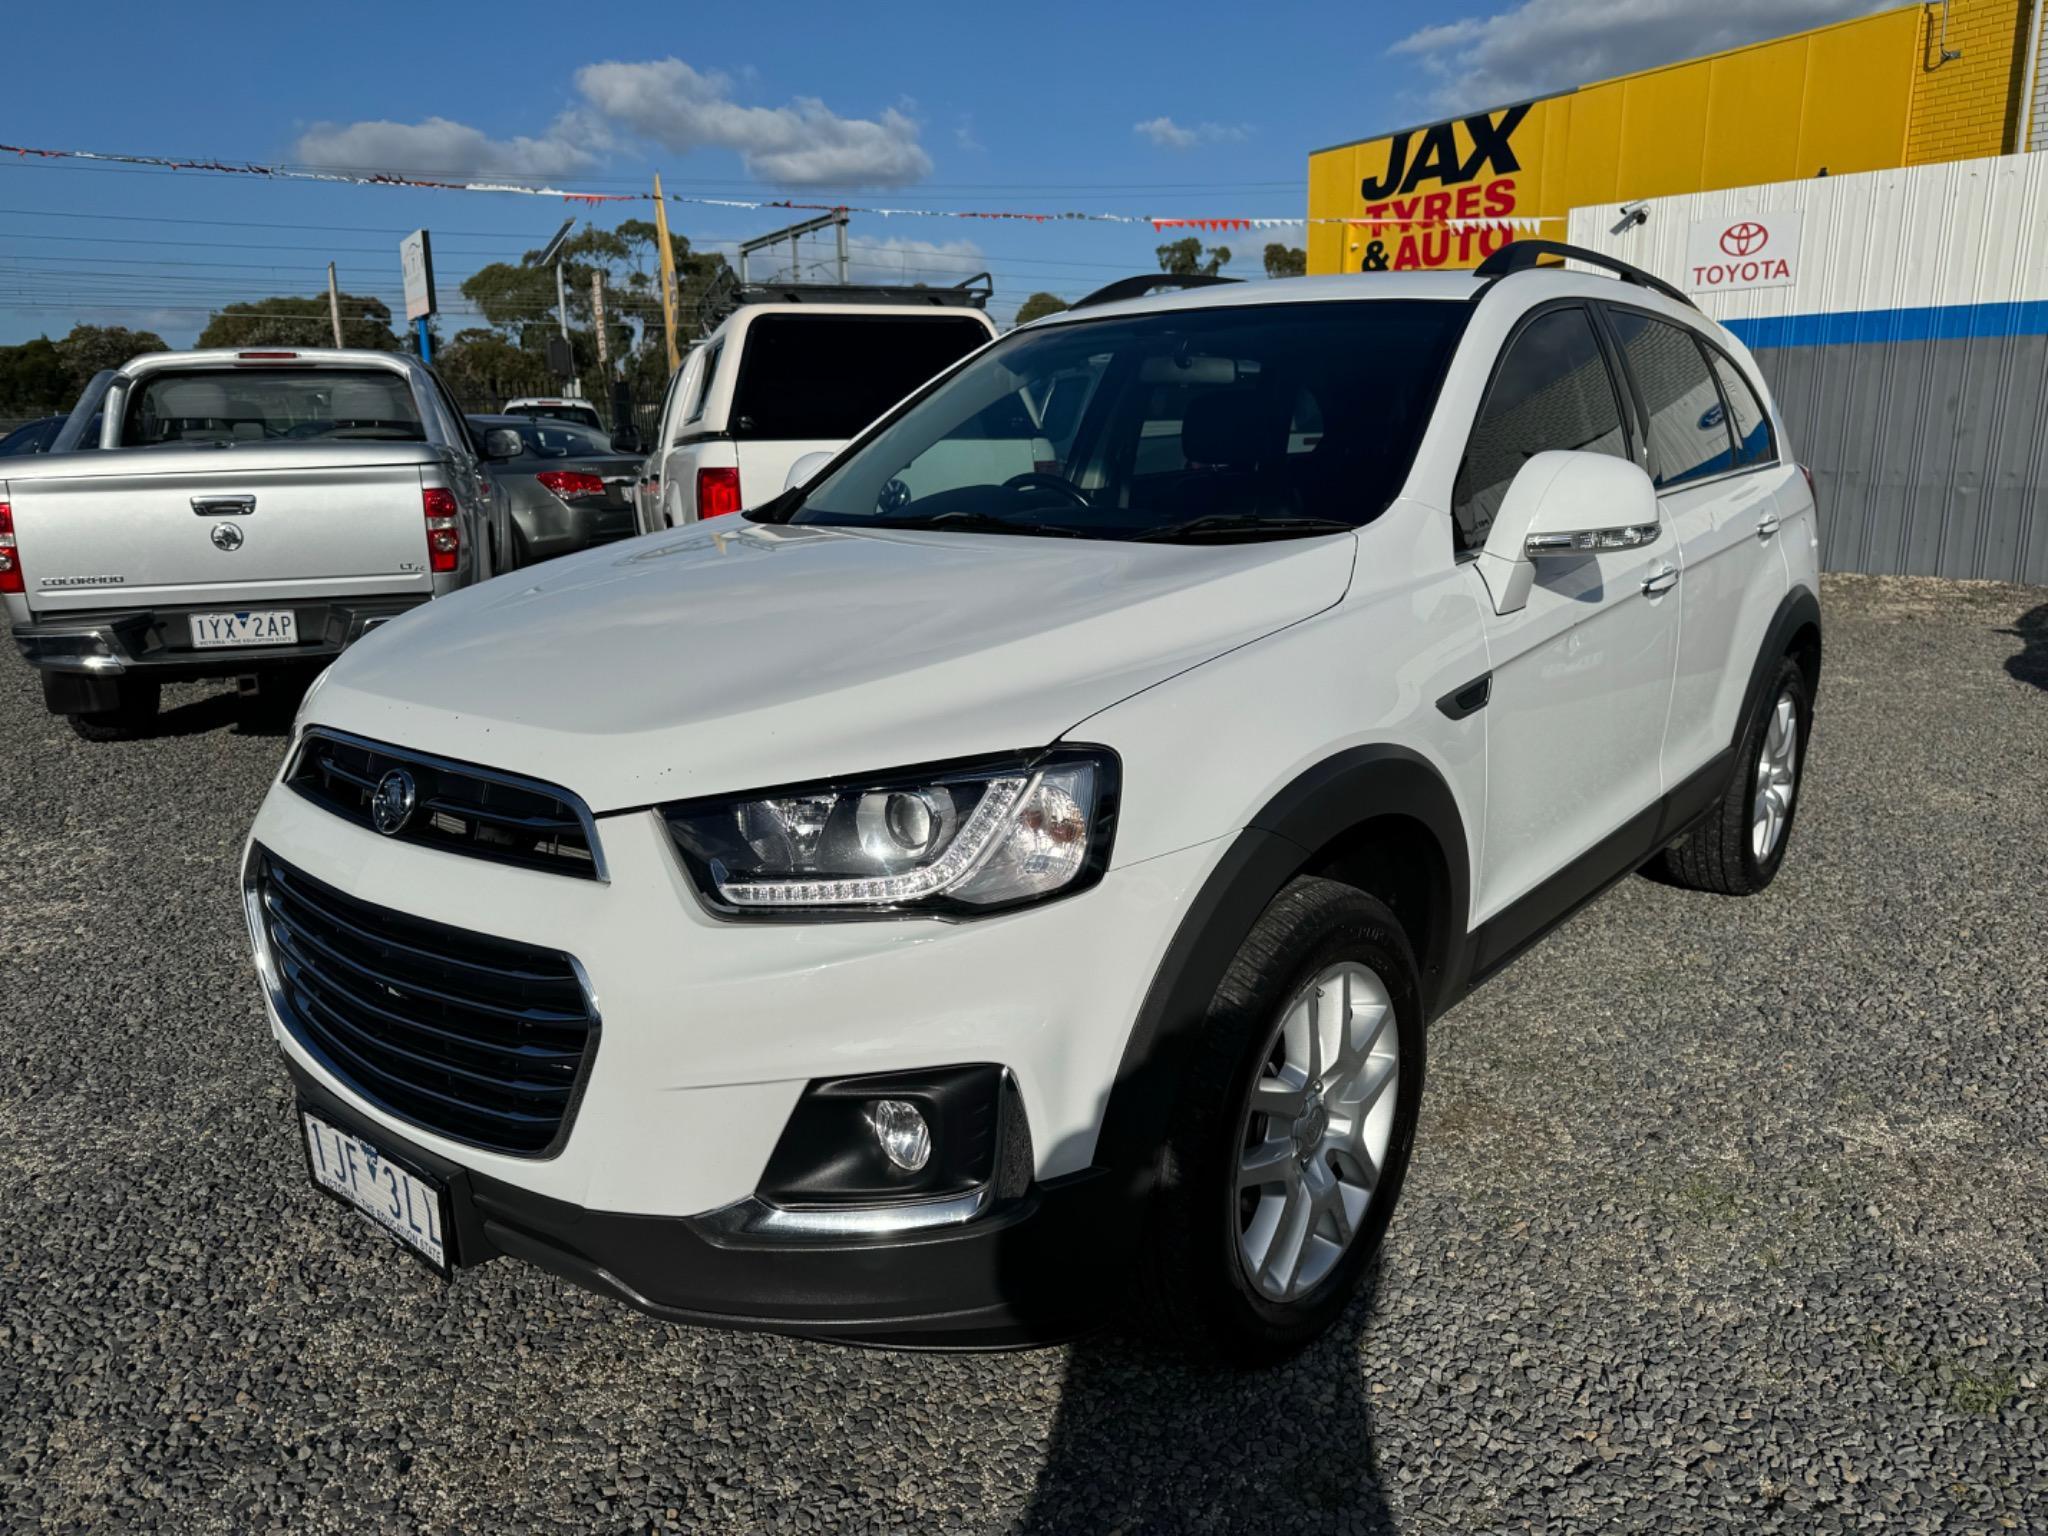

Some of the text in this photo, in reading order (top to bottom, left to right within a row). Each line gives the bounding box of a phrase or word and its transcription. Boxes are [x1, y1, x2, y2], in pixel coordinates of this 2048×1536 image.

[1361, 102, 1535, 202] JAX
[1366, 179, 1516, 238] TYRES
[1361, 223, 1514, 272] & AUTO
[1692, 258, 1790, 286] TOYOTA
[197, 616, 292, 640] 1YX 2AP
[311, 1122, 358, 1192] 1JF
